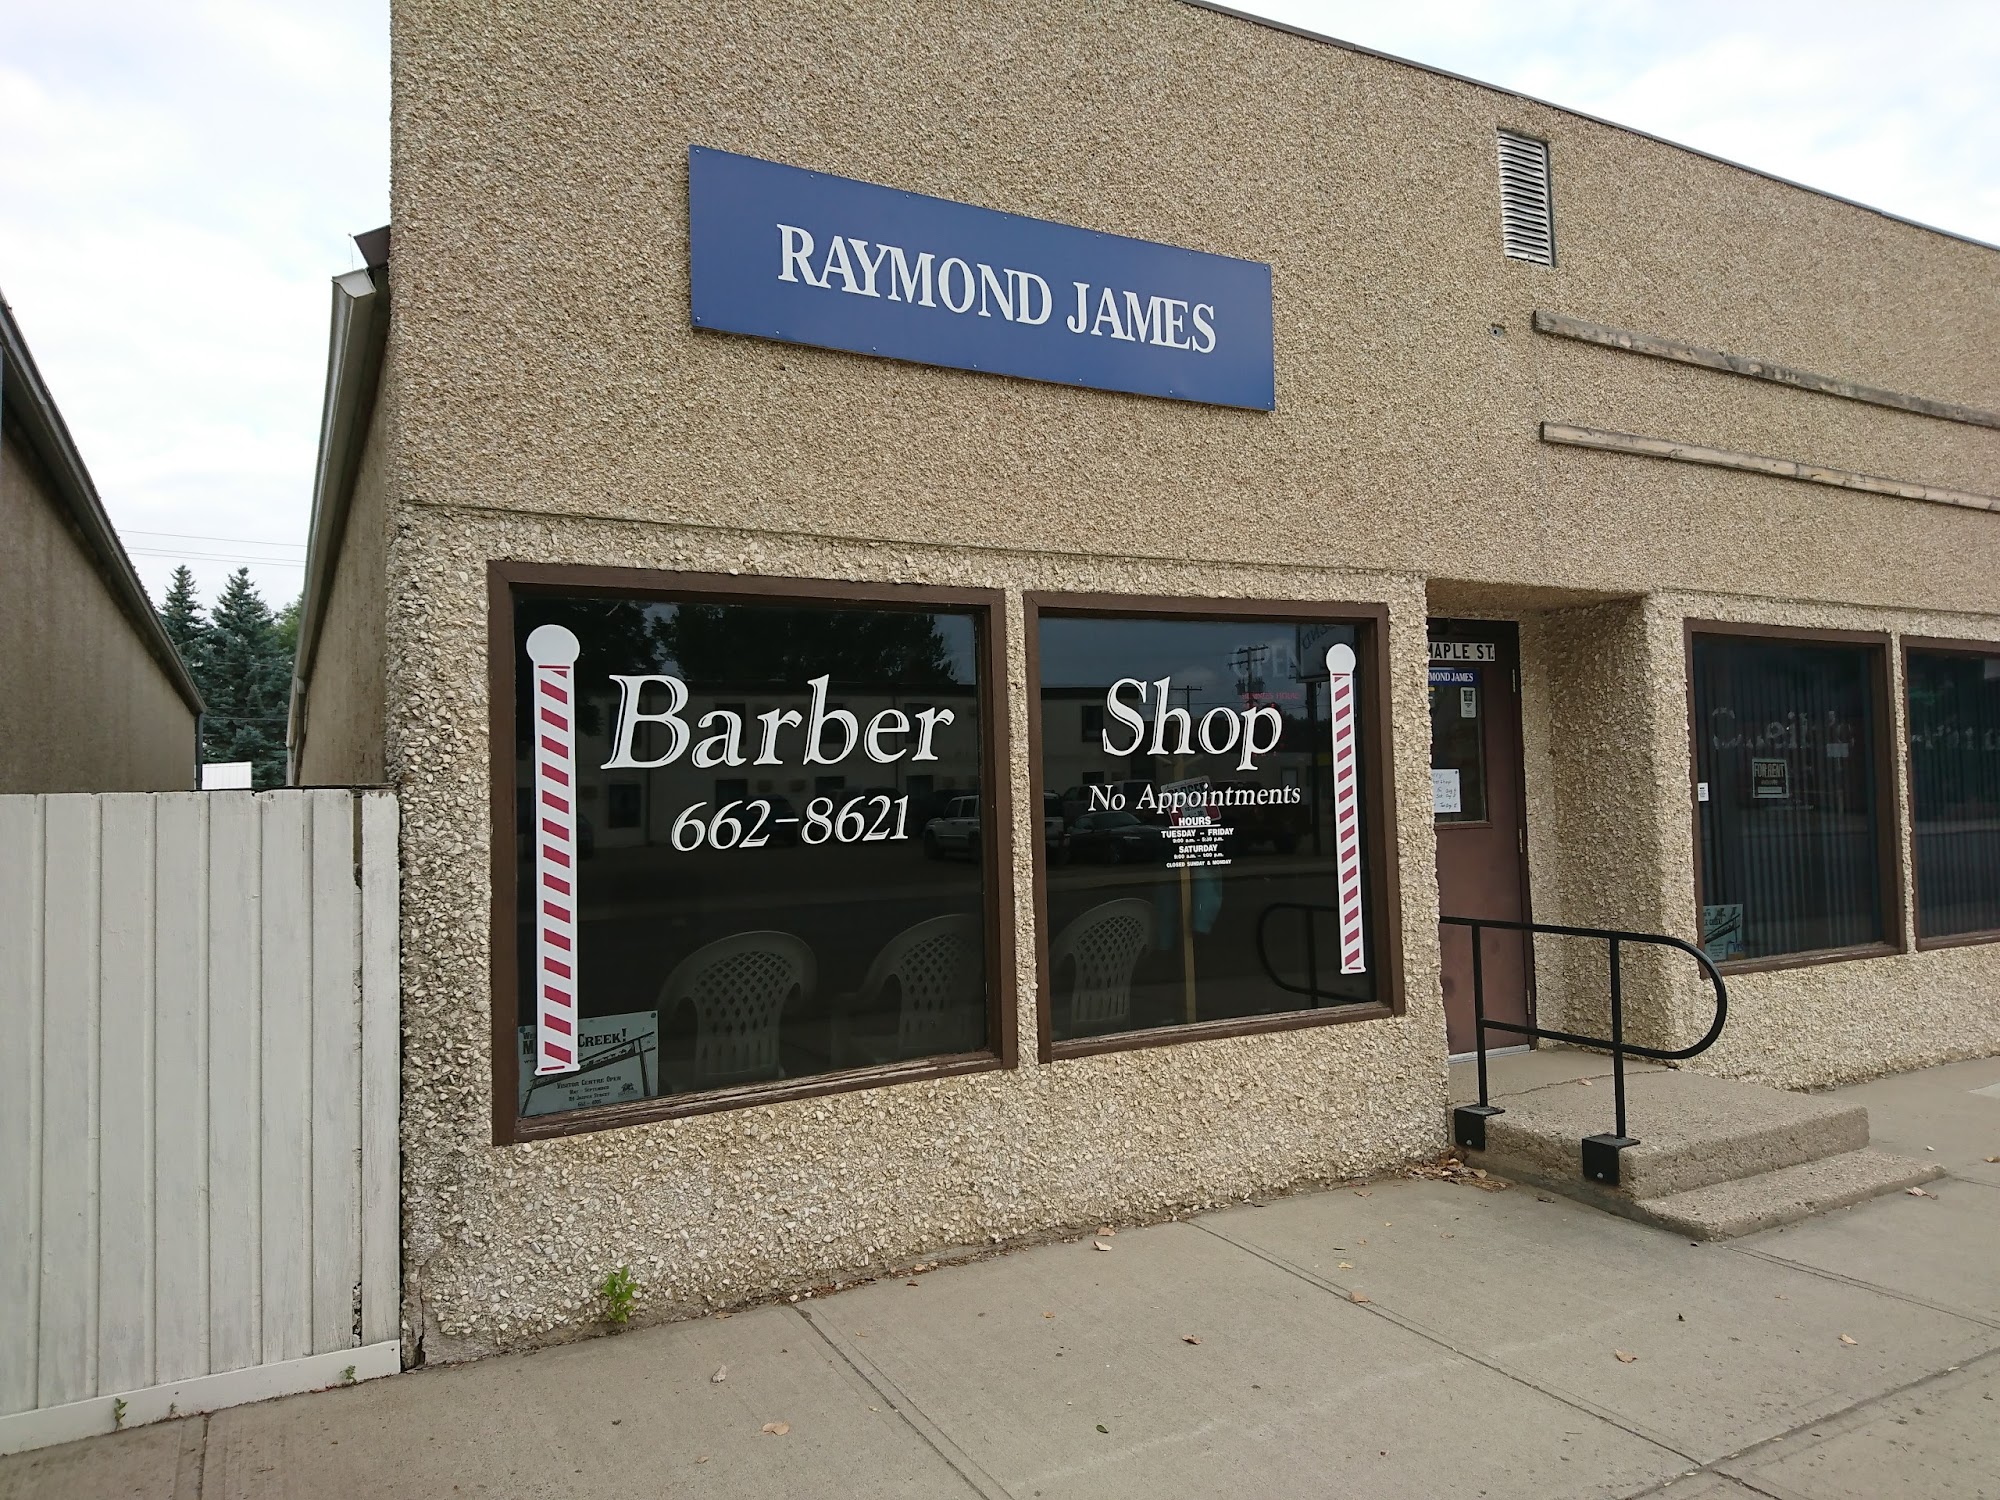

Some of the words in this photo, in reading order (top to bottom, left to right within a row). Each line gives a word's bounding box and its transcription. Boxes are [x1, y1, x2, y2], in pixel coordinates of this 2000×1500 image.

[776, 223, 1053, 326] RAYMOND
[1066, 281, 1218, 354] JAMES
[1476, 644, 1494, 660] ST.
[1428, 672, 1450, 682] MOND
[1451, 672, 1474, 682] JAMES
[600, 674, 955, 770] Barber
[1101, 676, 1283, 771] Shop
[1754, 763, 1767, 777] FOR
[1767, 763, 1785, 778] RENT
[1088, 784, 1126, 812] No
[1136, 782, 1301, 814] Appointments
[670, 794, 909, 852] 662-8621
[1178, 816, 1212, 826] HOURS
[1161, 829, 1196, 838] TUESDAY
[1207, 827, 1234, 836] FRIDAY
[1178, 844, 1218, 853] SATURDAY
